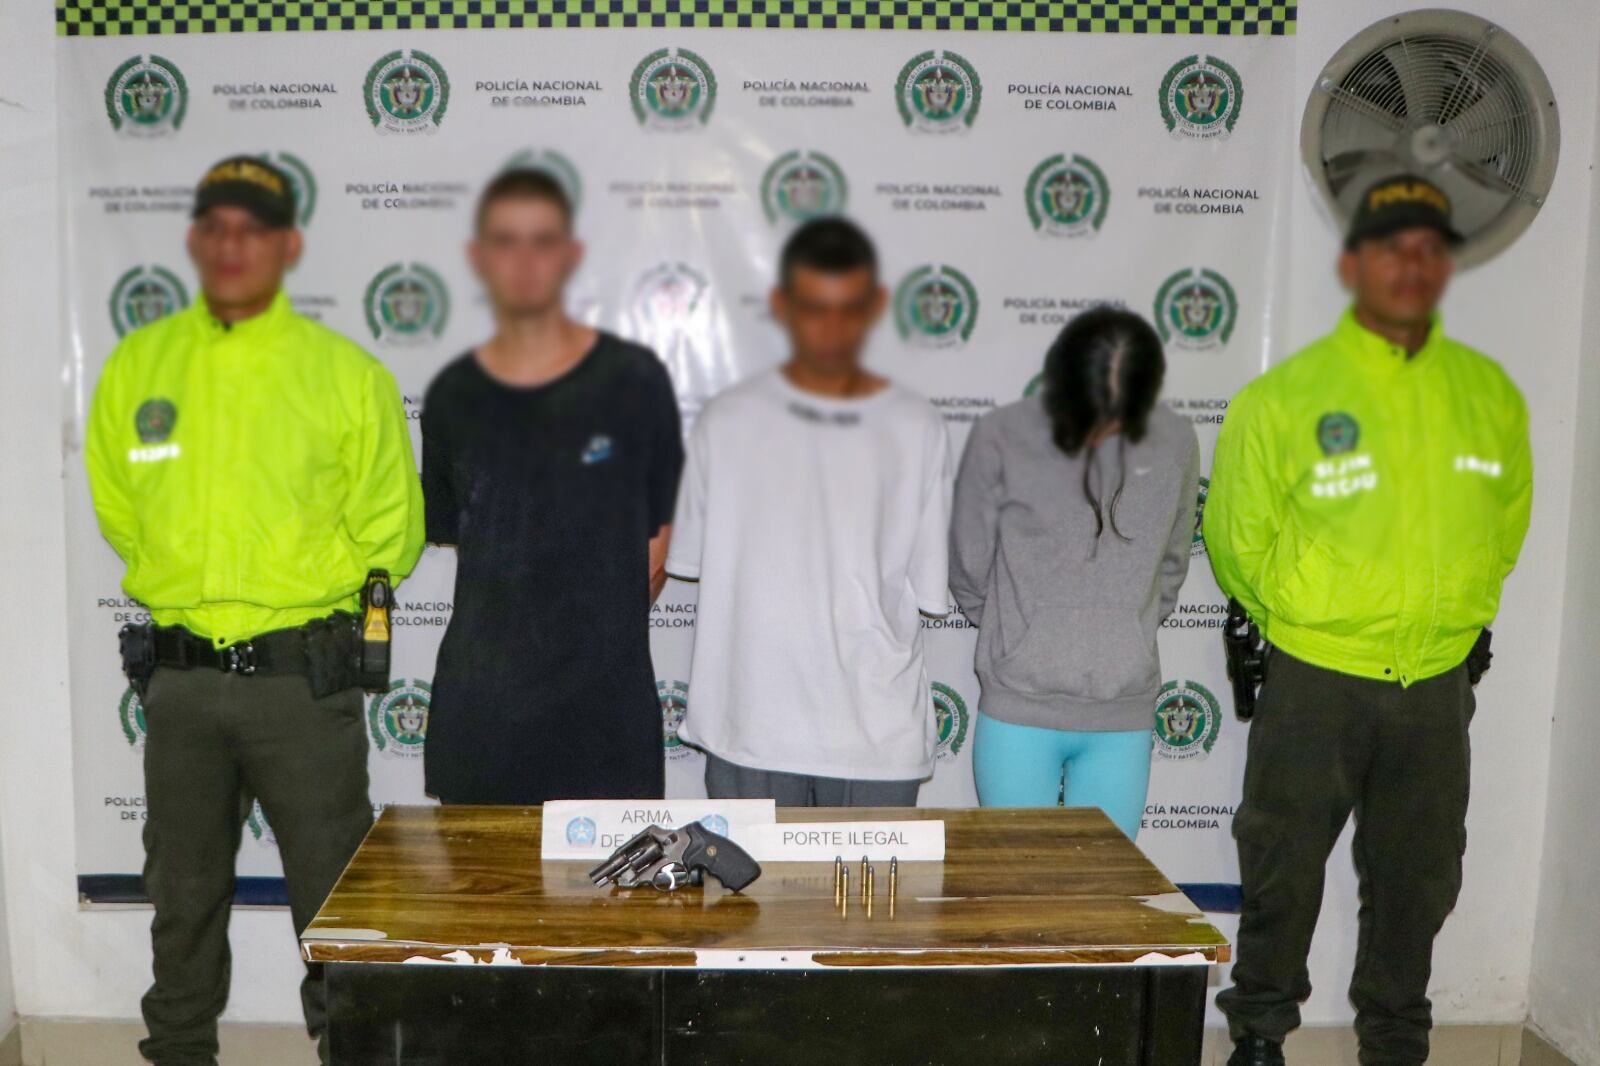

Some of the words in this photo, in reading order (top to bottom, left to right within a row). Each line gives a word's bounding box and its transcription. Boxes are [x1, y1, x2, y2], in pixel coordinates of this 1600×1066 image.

[270, 83, 338, 95] NACIONAL
[475, 78, 529, 91] POLICÍA
[532, 80, 603, 91] NACIONAL
[743, 79, 797, 91] POLICÍA
[800, 81, 870, 92] NACIONAL
[1007, 84, 1061, 95] POLICÍA
[1065, 85, 1133, 97] NACIONAL
[250, 98, 322, 110] COLOMBIA
[491, 96, 510, 107] DE
[512, 96, 587, 107] COLOMBIA
[1024, 99, 1043, 110] DE
[1046, 100, 1117, 111] COLOMBIA
[1193, 189, 1260, 200] NACIONAL
[1175, 203, 1245, 214] COLOMBIA
[665, 604, 697, 613] NACI
[1180, 604, 1229, 614] NACION
[114, 612, 131, 622] DE
[391, 616, 448, 626] COLOMBI
[649, 618, 695, 628] COLOM
[121, 811, 137, 820] DE
[1170, 805, 1235, 815] NACIONAL
[621, 809, 673, 824] ARMA
[1152, 819, 1220, 829] COLOMBIA
[601, 833, 625, 848] DE
[783, 831, 843, 846] PORTE
[848, 830, 908, 846] ILEGAL
